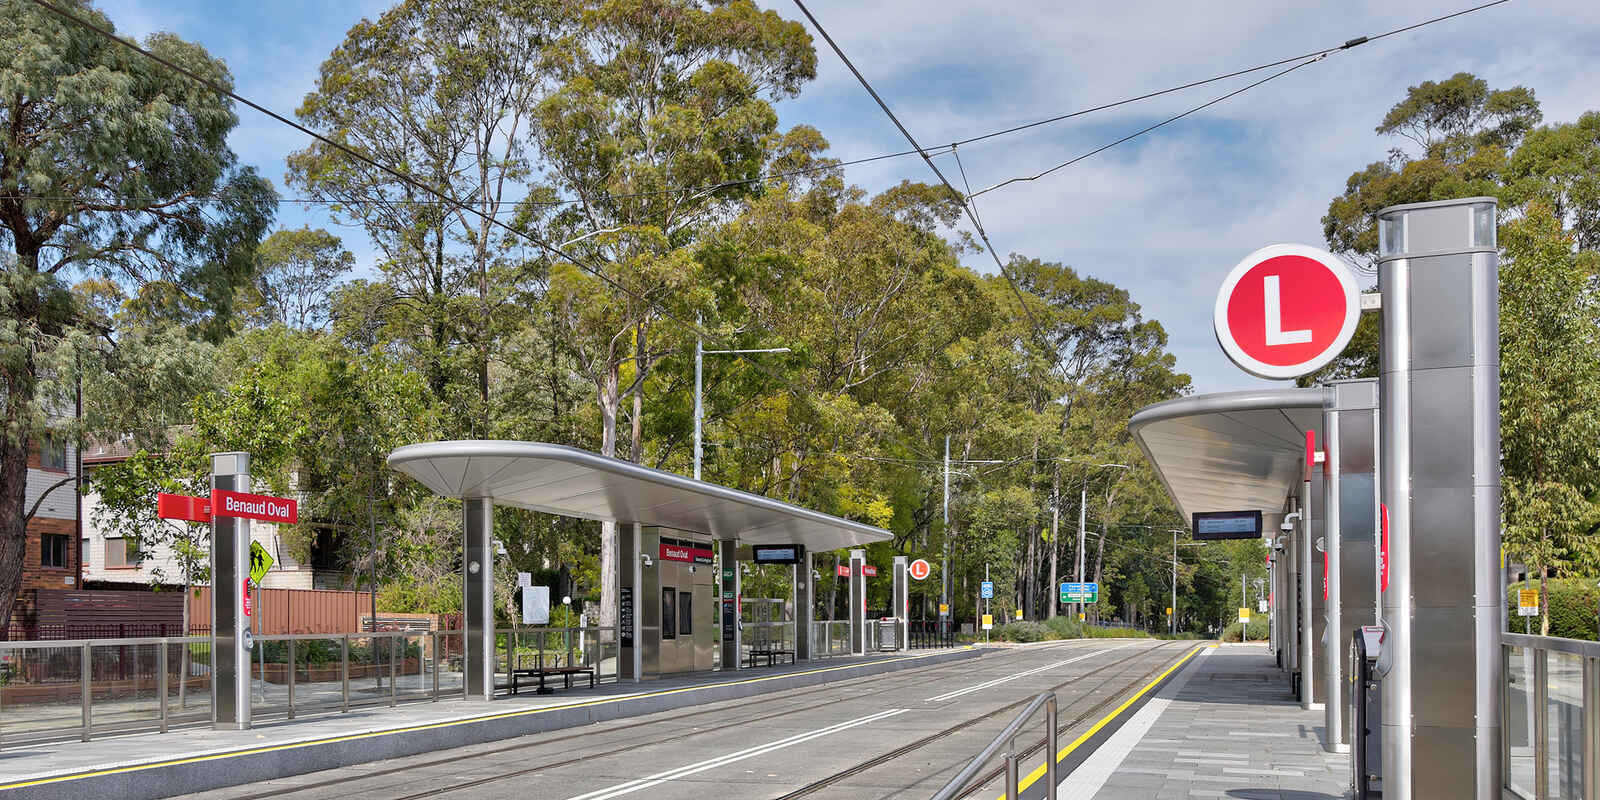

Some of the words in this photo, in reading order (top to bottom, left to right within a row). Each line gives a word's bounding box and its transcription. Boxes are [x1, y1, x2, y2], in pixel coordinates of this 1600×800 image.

[1263, 274, 1313, 347] L
[225, 496, 266, 515] Benaud
[267, 501, 290, 518] Oval
[915, 563, 924, 576] L
